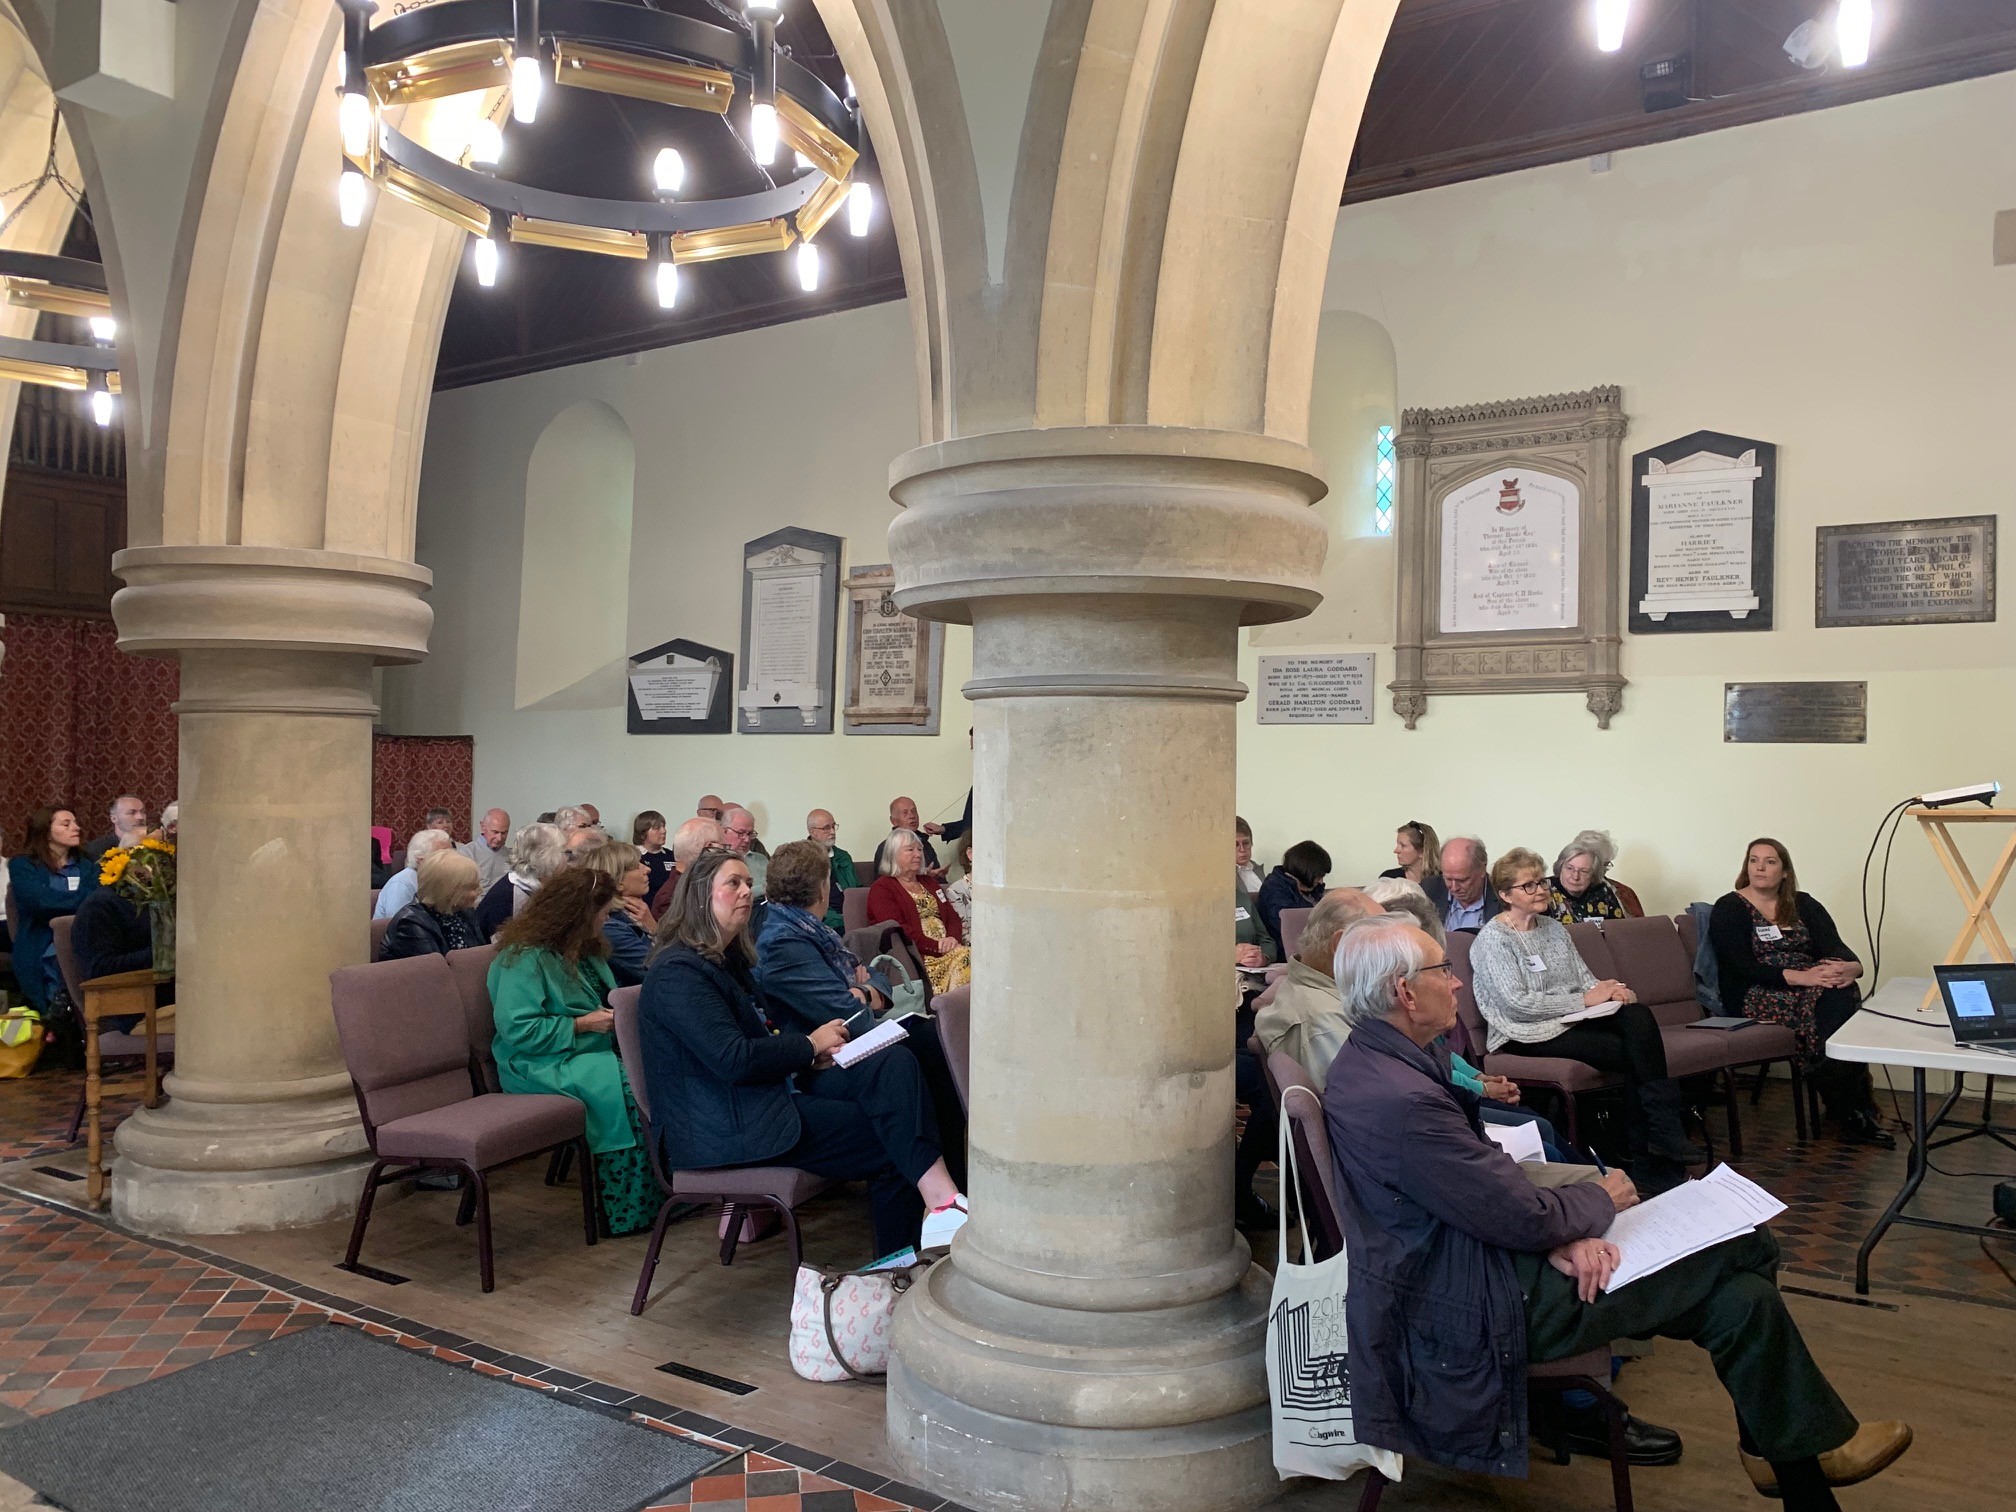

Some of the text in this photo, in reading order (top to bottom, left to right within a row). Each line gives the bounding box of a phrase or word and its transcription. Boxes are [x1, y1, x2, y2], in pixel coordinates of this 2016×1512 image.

[1658, 502, 1698, 510] MARIANNE
[1906, 537, 1939, 546] MEMORY
[1865, 548, 1906, 558] EORGE
[1861, 592, 1898, 601] HURCH
[1923, 590, 1972, 598] RESTORED
[1312, 1322, 1347, 1342] WORL
